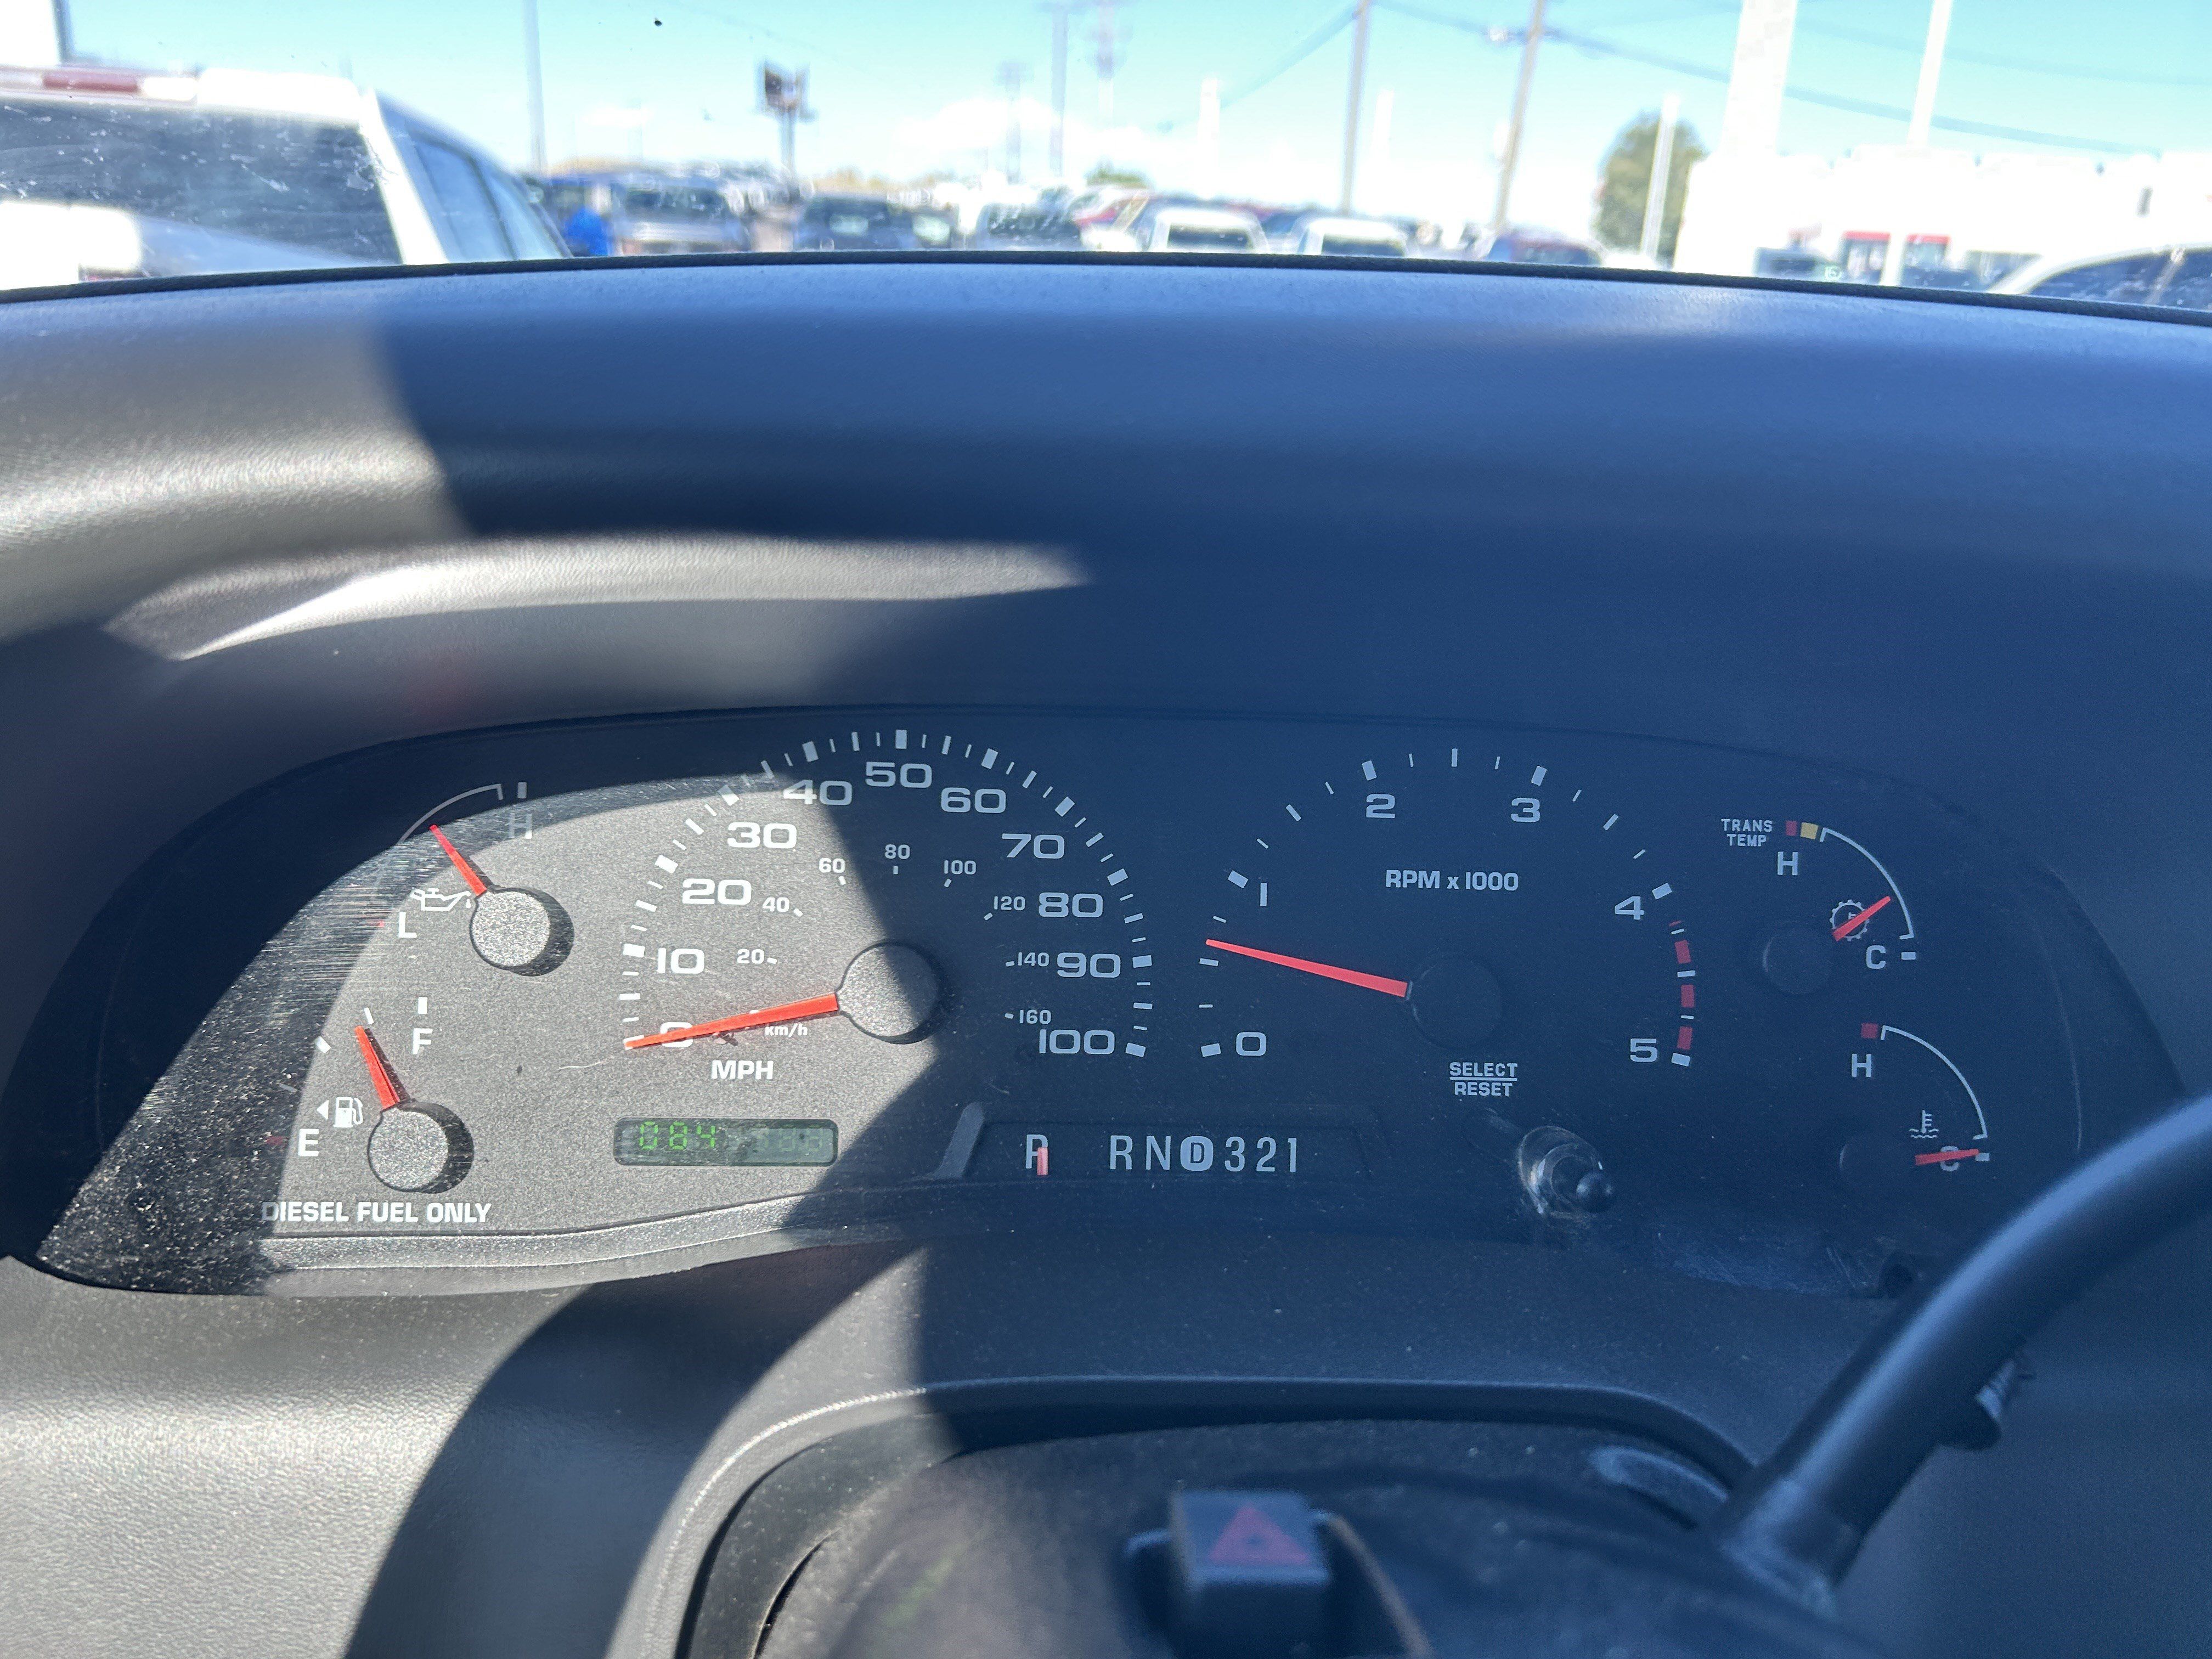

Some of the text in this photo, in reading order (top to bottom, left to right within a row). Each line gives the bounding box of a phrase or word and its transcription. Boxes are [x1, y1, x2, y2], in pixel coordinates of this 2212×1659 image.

[865, 761, 932, 789] 50
[782, 779, 853, 806] 40
[940, 787, 1007, 814] 60
[1365, 793, 1397, 820] 2
[1510, 797, 1541, 823] 3
[726, 821, 797, 849] 30
[1720, 818, 1774, 833] TRANS
[884, 843, 911, 860] 80
[1001, 832, 1065, 860] 70
[1726, 833, 1768, 847] TEMP
[818, 857, 847, 874] 60
[943, 860, 977, 876] 100
[1776, 850, 1799, 876] H
[681, 878, 752, 905] 20
[1385, 868, 1441, 890] RPM
[1464, 871, 1520, 893] 1000
[761, 896, 790, 912] 40
[992, 895, 1026, 911] 120
[1038, 891, 1104, 918] 80
[1613, 895, 1645, 921] 4
[397, 911, 418, 939] L
[657, 947, 706, 974] 10
[736, 949, 765, 964] 20
[1017, 952, 1050, 967] 140
[1056, 952, 1121, 979] 90
[1865, 944, 1887, 970] C
[764, 1023, 809, 1037] km/h
[1019, 1009, 1052, 1025] 160
[412, 1027, 433, 1055] F
[1039, 1028, 1116, 1056] 100
[1235, 1031, 1267, 1057] 0
[1629, 1037, 1659, 1064] 5
[710, 1059, 775, 1081] MPH
[1449, 1062, 1519, 1078] SELECT
[1851, 1053, 1873, 1078] H
[1453, 1082, 1514, 1097] RESET
[297, 1128, 320, 1157] E
[261, 1201, 492, 1223] DIESEL FUEL ONLY
